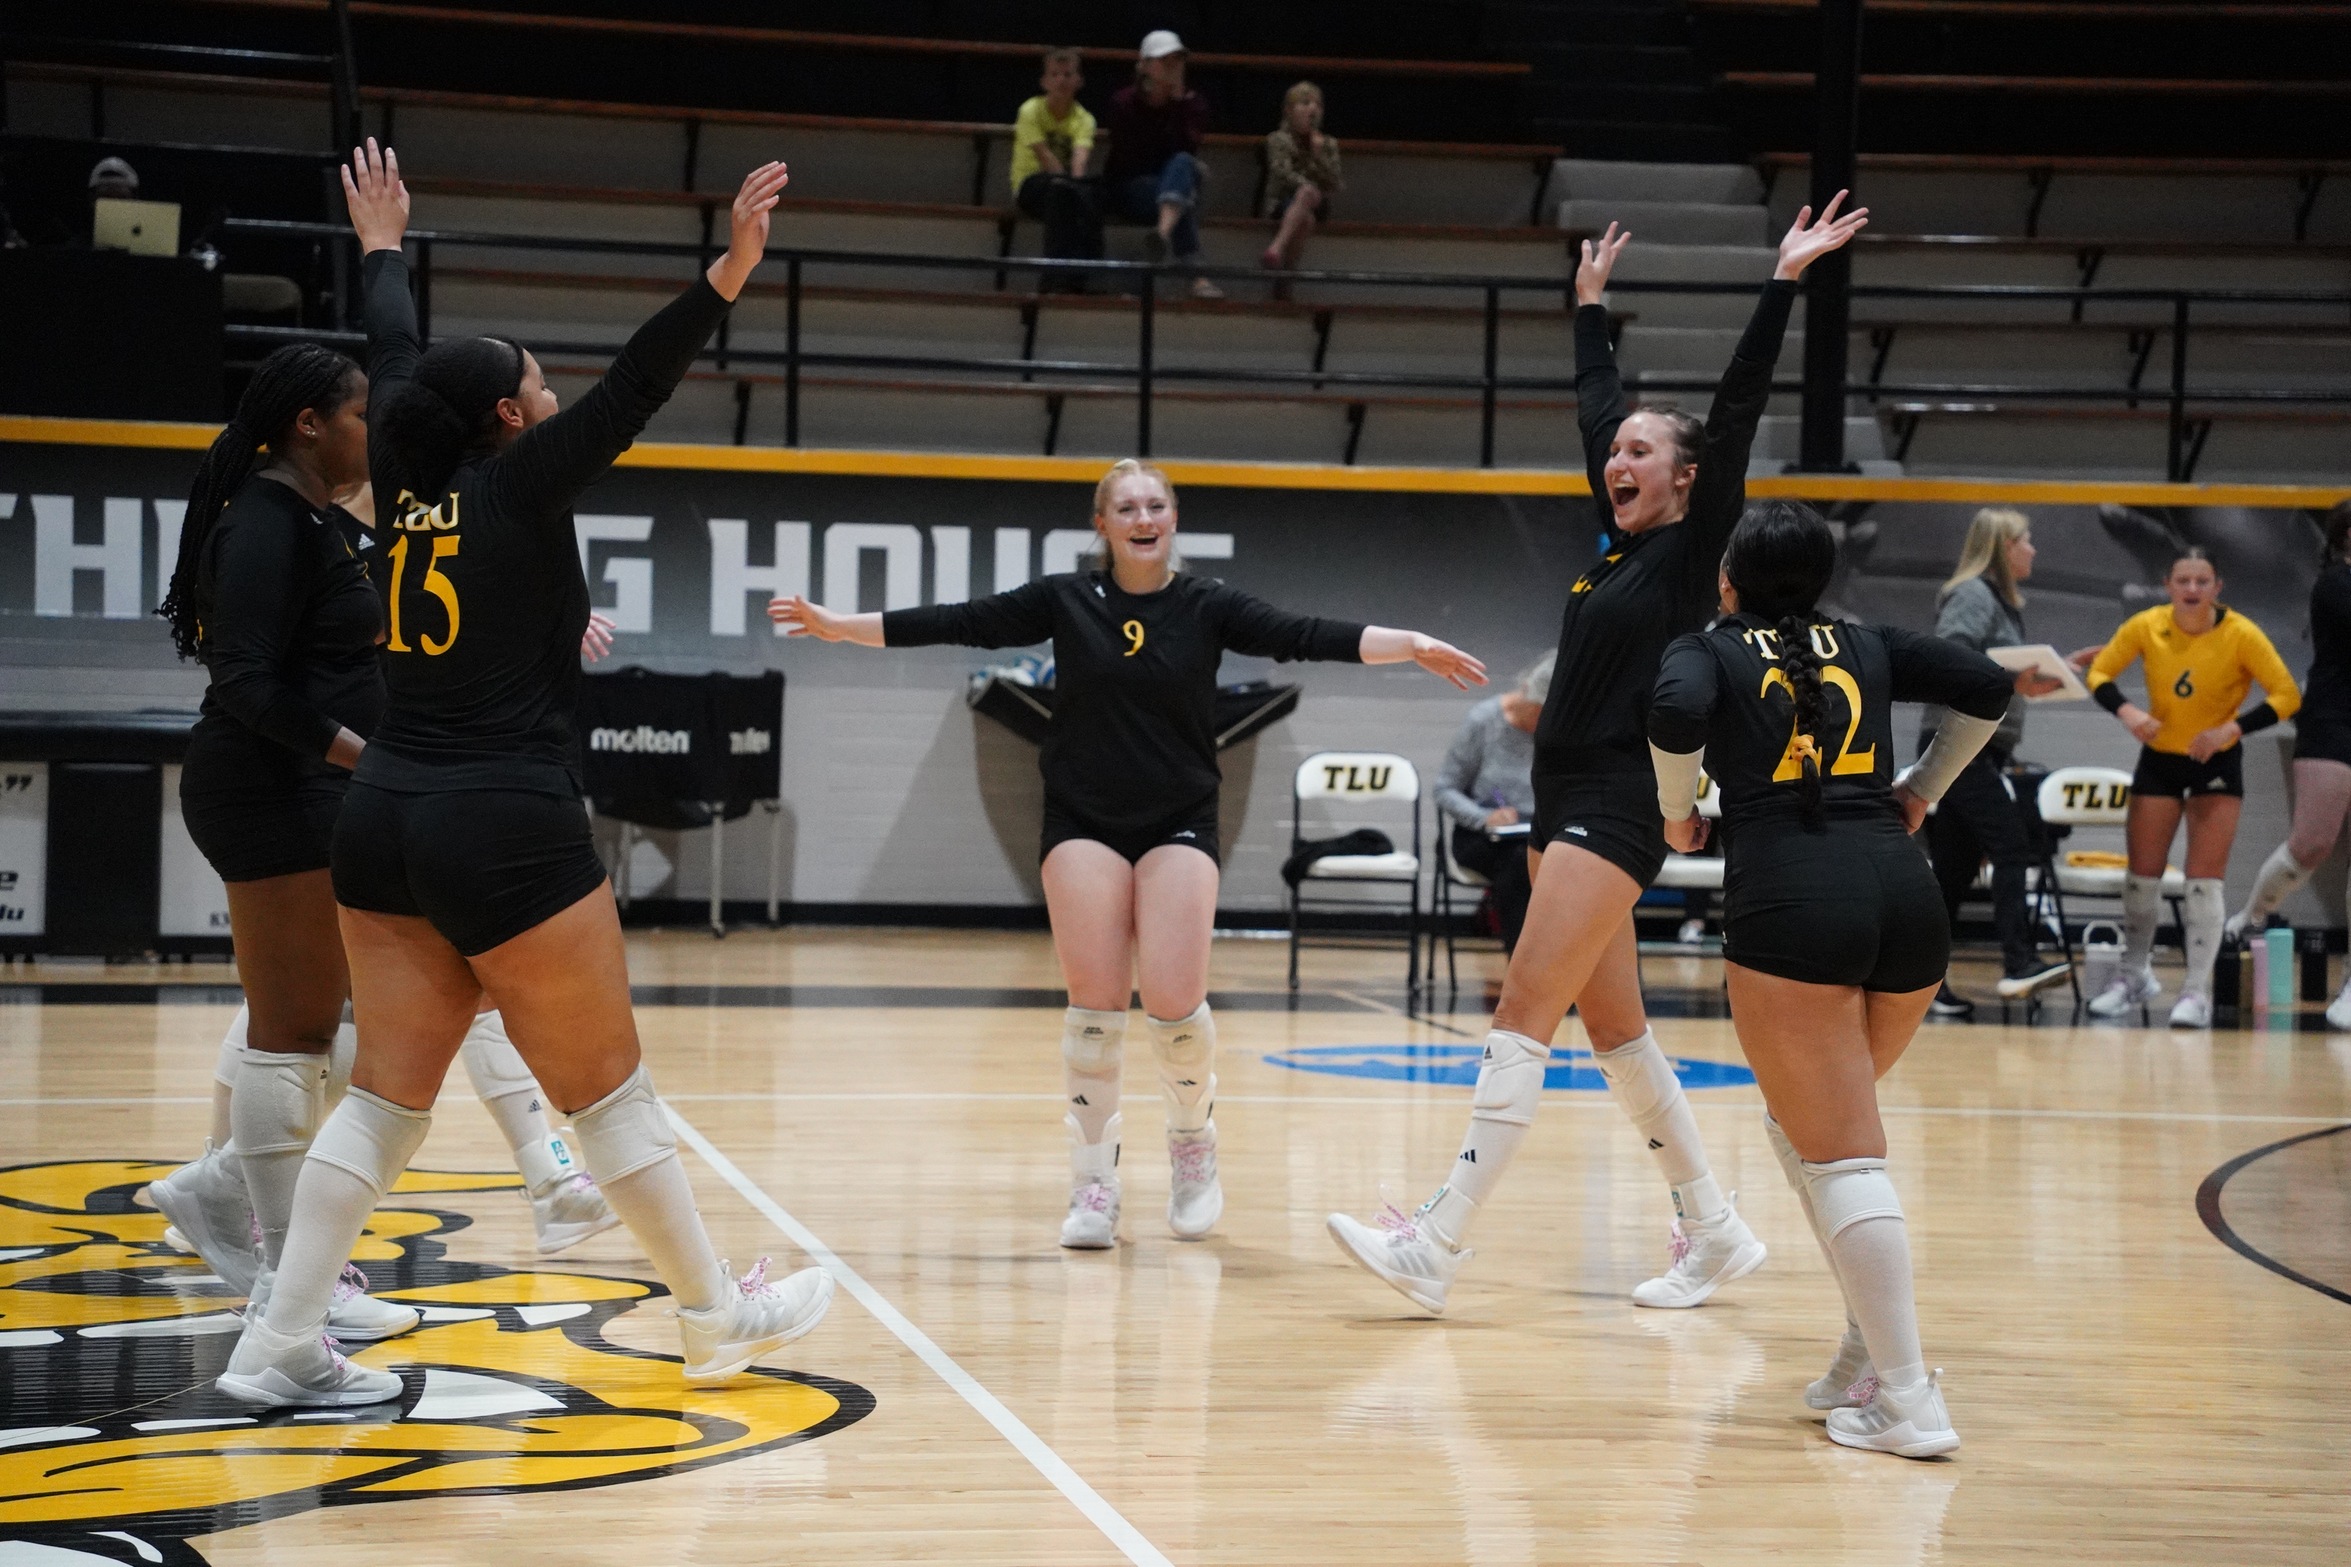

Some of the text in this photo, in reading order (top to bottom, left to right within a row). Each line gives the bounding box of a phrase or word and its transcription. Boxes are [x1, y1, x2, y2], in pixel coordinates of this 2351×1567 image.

[387, 533, 461, 656] 15
[1122, 619, 1144, 657] 9
[1743, 624, 1839, 660] TU
[2174, 669, 2193, 698] 6
[590, 725, 691, 754] molten
[1760, 665, 1876, 783] 22
[1323, 765, 1392, 791] TLU
[2063, 783, 2129, 810] TLU
